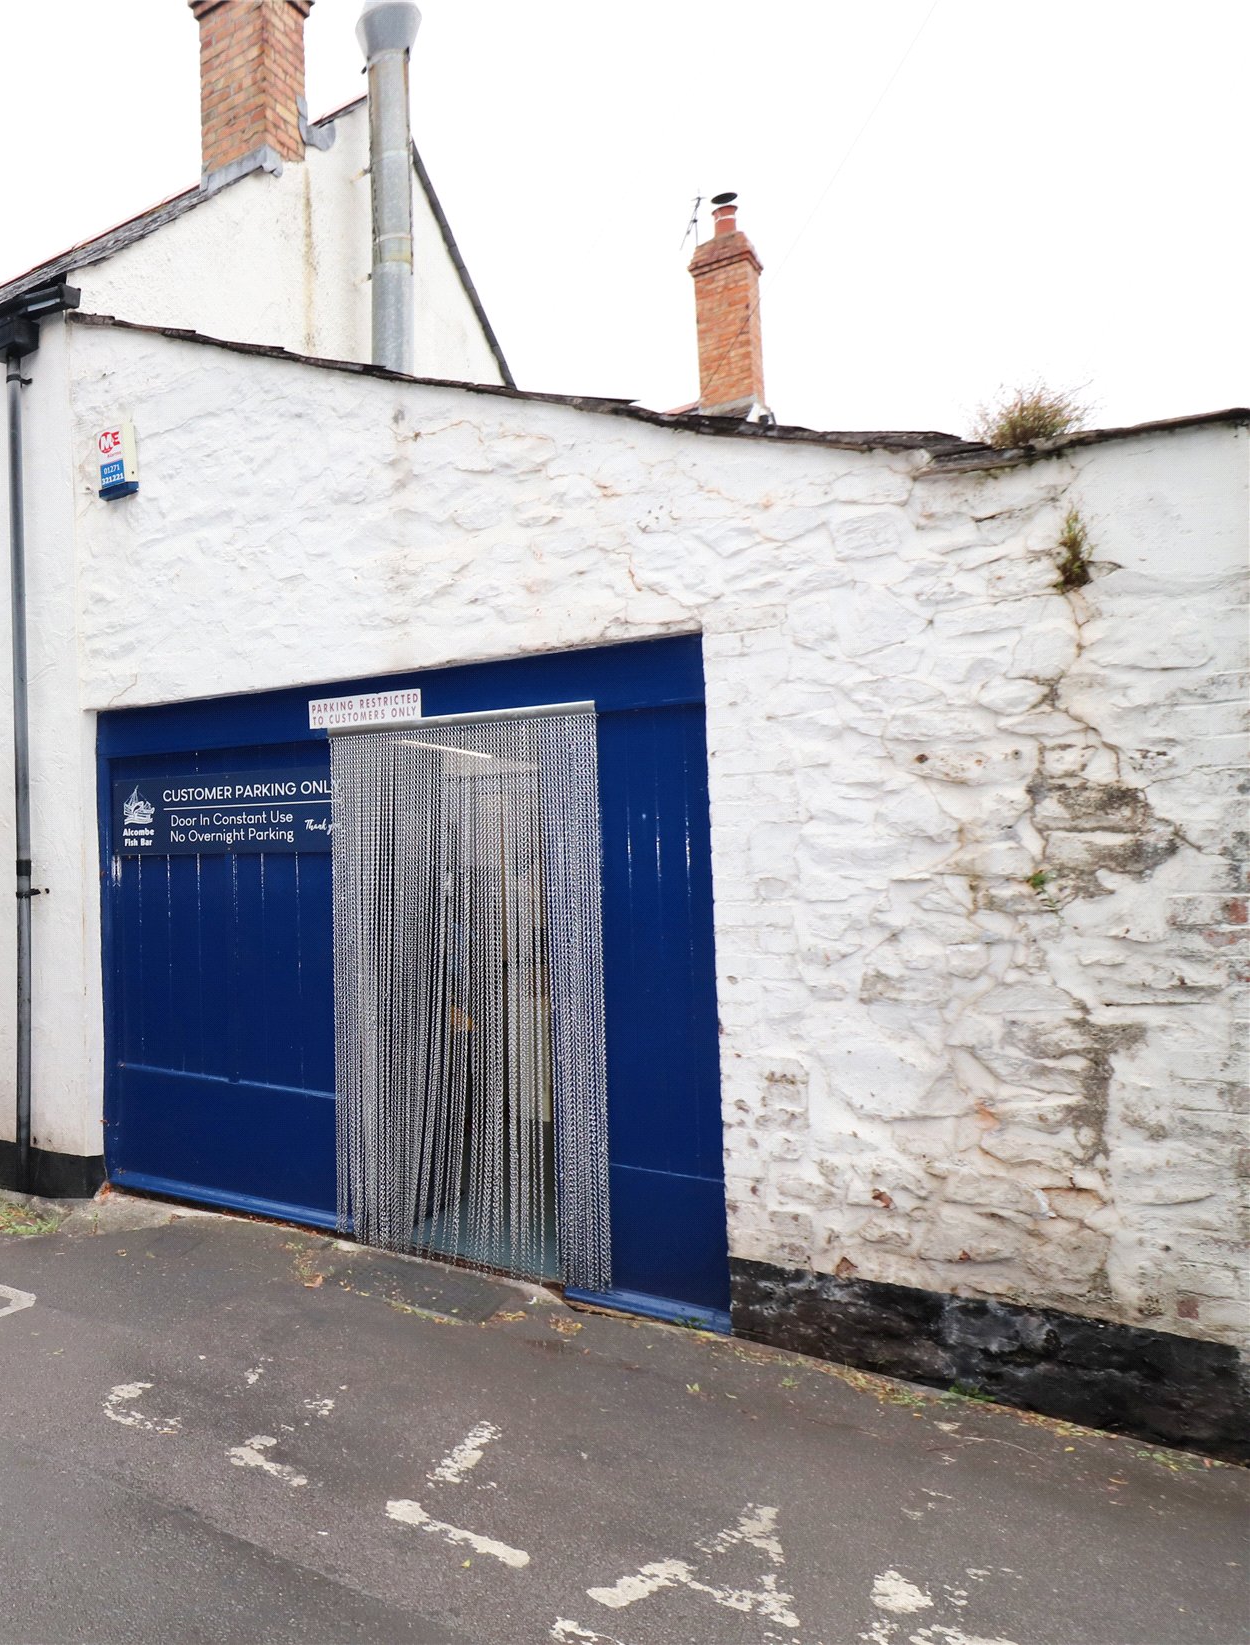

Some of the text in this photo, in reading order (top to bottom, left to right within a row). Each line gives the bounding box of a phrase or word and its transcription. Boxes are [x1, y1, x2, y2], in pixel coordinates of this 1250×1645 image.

[103, 464, 120, 475] 01271
[102, 472, 124, 485] 321221
[312, 693, 418, 715] PARKING RESTRICTED
[312, 706, 417, 726] TO CUSTOMERS ONLY
[162, 786, 232, 802] CUSTOMER
[235, 782, 297, 799] PARKING
[170, 810, 293, 827] Door In Constant Use
[304, 818, 327, 831] Thank
[123, 827, 155, 837] Alcombe
[170, 827, 294, 845] No Overnight Parking
[124, 838, 153, 847] Fish Bar
